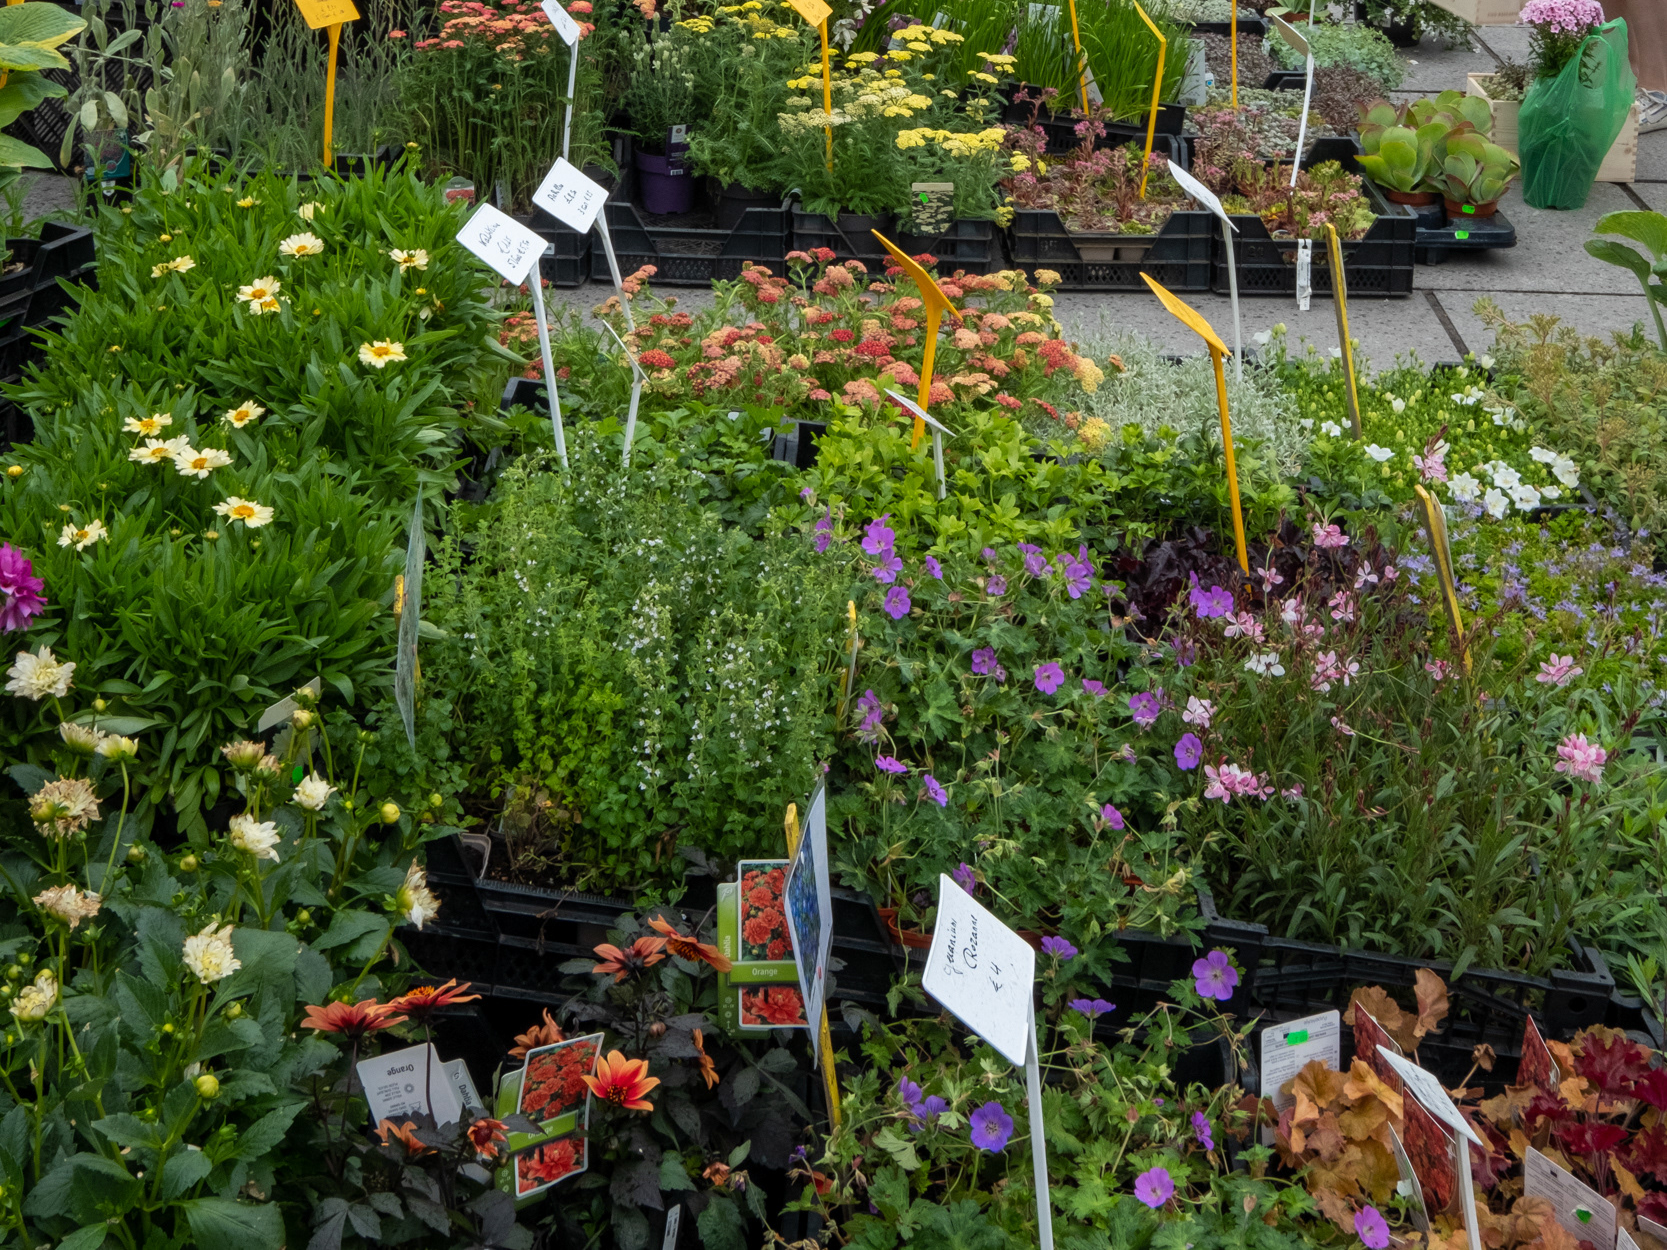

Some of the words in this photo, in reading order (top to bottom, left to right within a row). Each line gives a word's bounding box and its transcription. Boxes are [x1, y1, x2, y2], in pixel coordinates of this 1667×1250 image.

[752, 967, 778, 977] Orange
[387, 1064, 414, 1076] Orange
[459, 1084, 472, 1106] Dahlia
[528, 1126, 553, 1140] Orge
